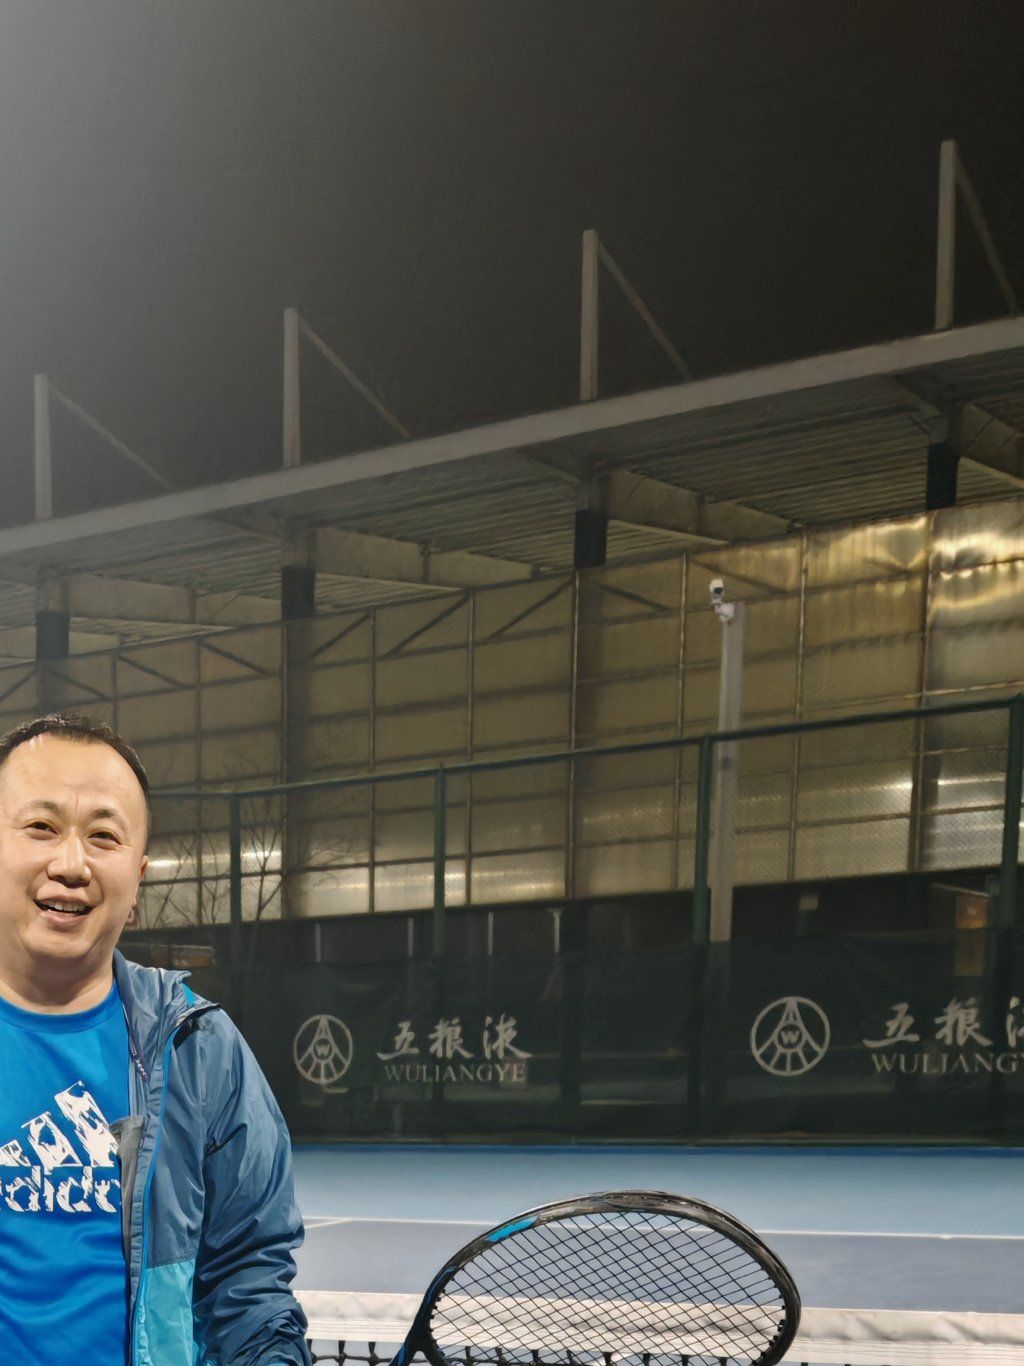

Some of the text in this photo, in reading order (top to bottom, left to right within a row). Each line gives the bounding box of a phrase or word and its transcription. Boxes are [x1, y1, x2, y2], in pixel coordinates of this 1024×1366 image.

[377, 1013, 533, 1061] 五粮液
[384, 1063, 528, 1083] WULIANGYE
[872, 1052, 1024, 1075] WULIANG
